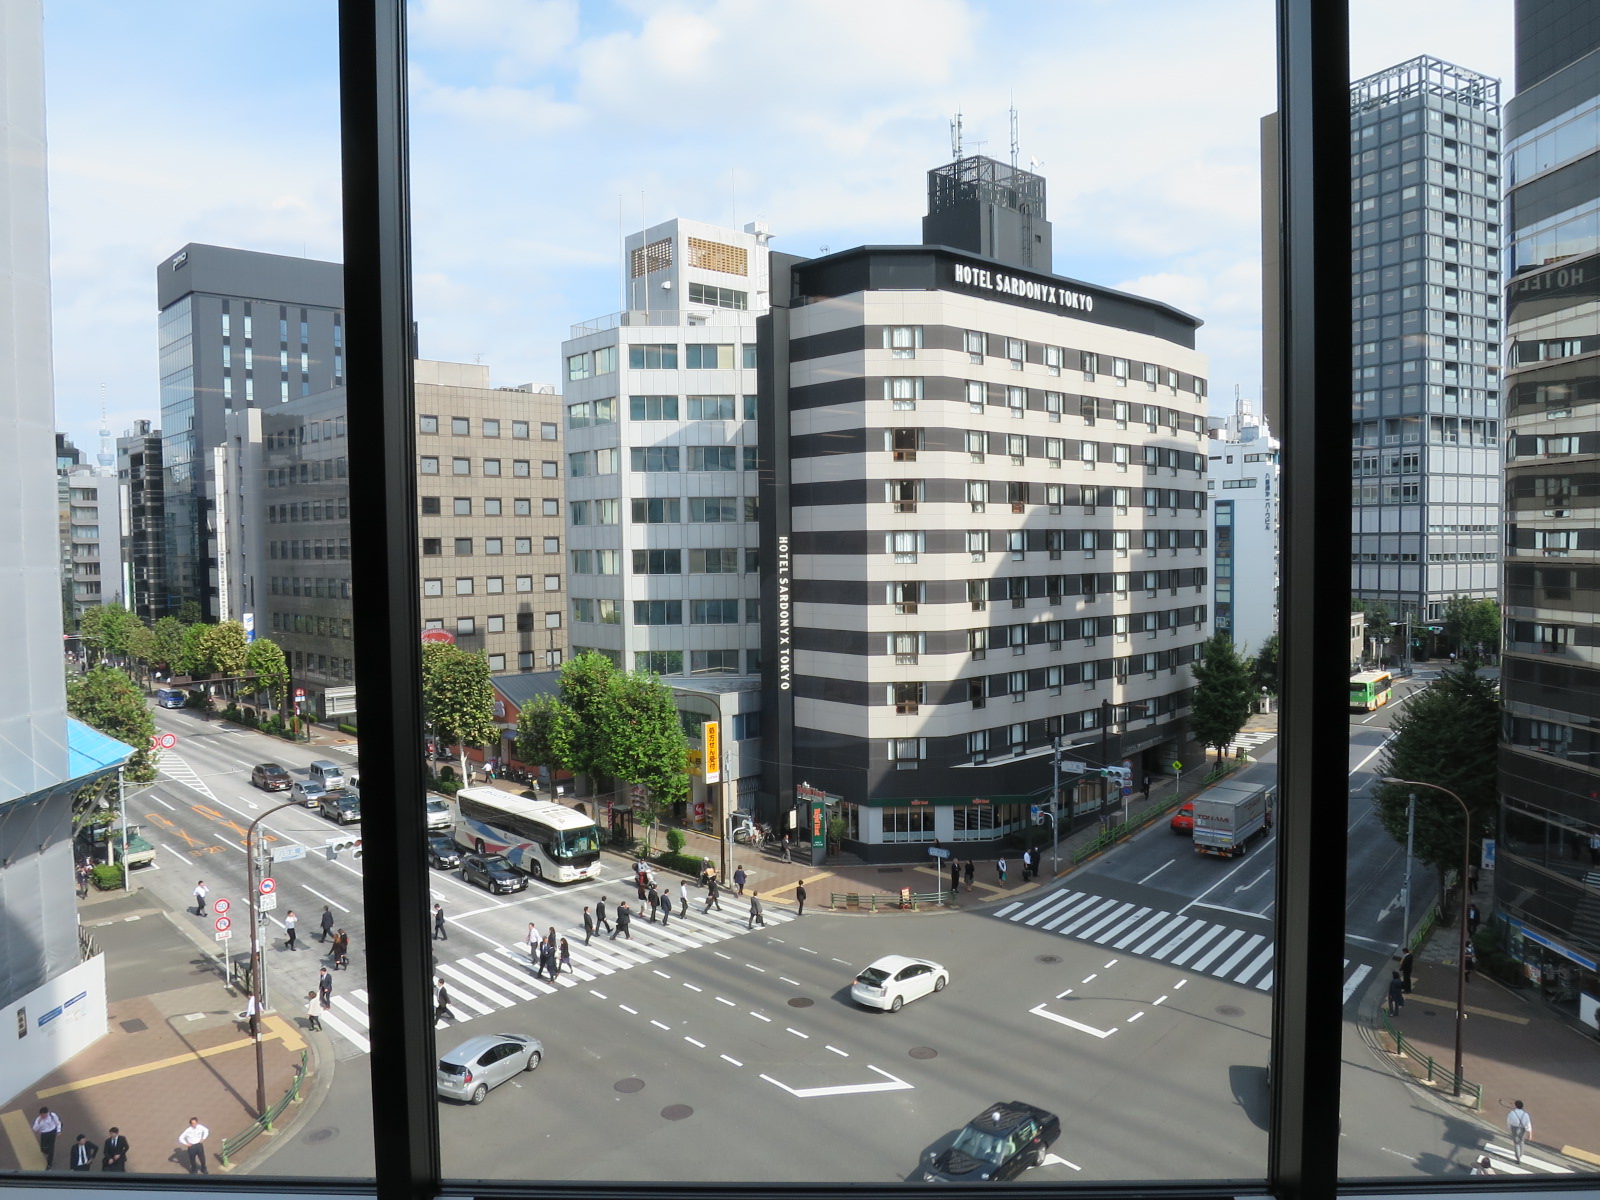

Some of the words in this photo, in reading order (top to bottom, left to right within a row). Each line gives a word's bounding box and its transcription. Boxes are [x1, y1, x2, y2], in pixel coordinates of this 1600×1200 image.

[955, 263, 993, 290] HOTEL
[996, 273, 1057, 304] SARDONYX
[1058, 289, 1093, 312] TOKYO
[778, 536, 789, 575] HOTEL
[779, 577, 790, 645] SARDONYX
[780, 648, 790, 690] TOKYO
[708, 726, 716, 770] 処方せん受付
[813, 808, 821, 824] Royal
[1197, 814, 1230, 823] TONAMI
